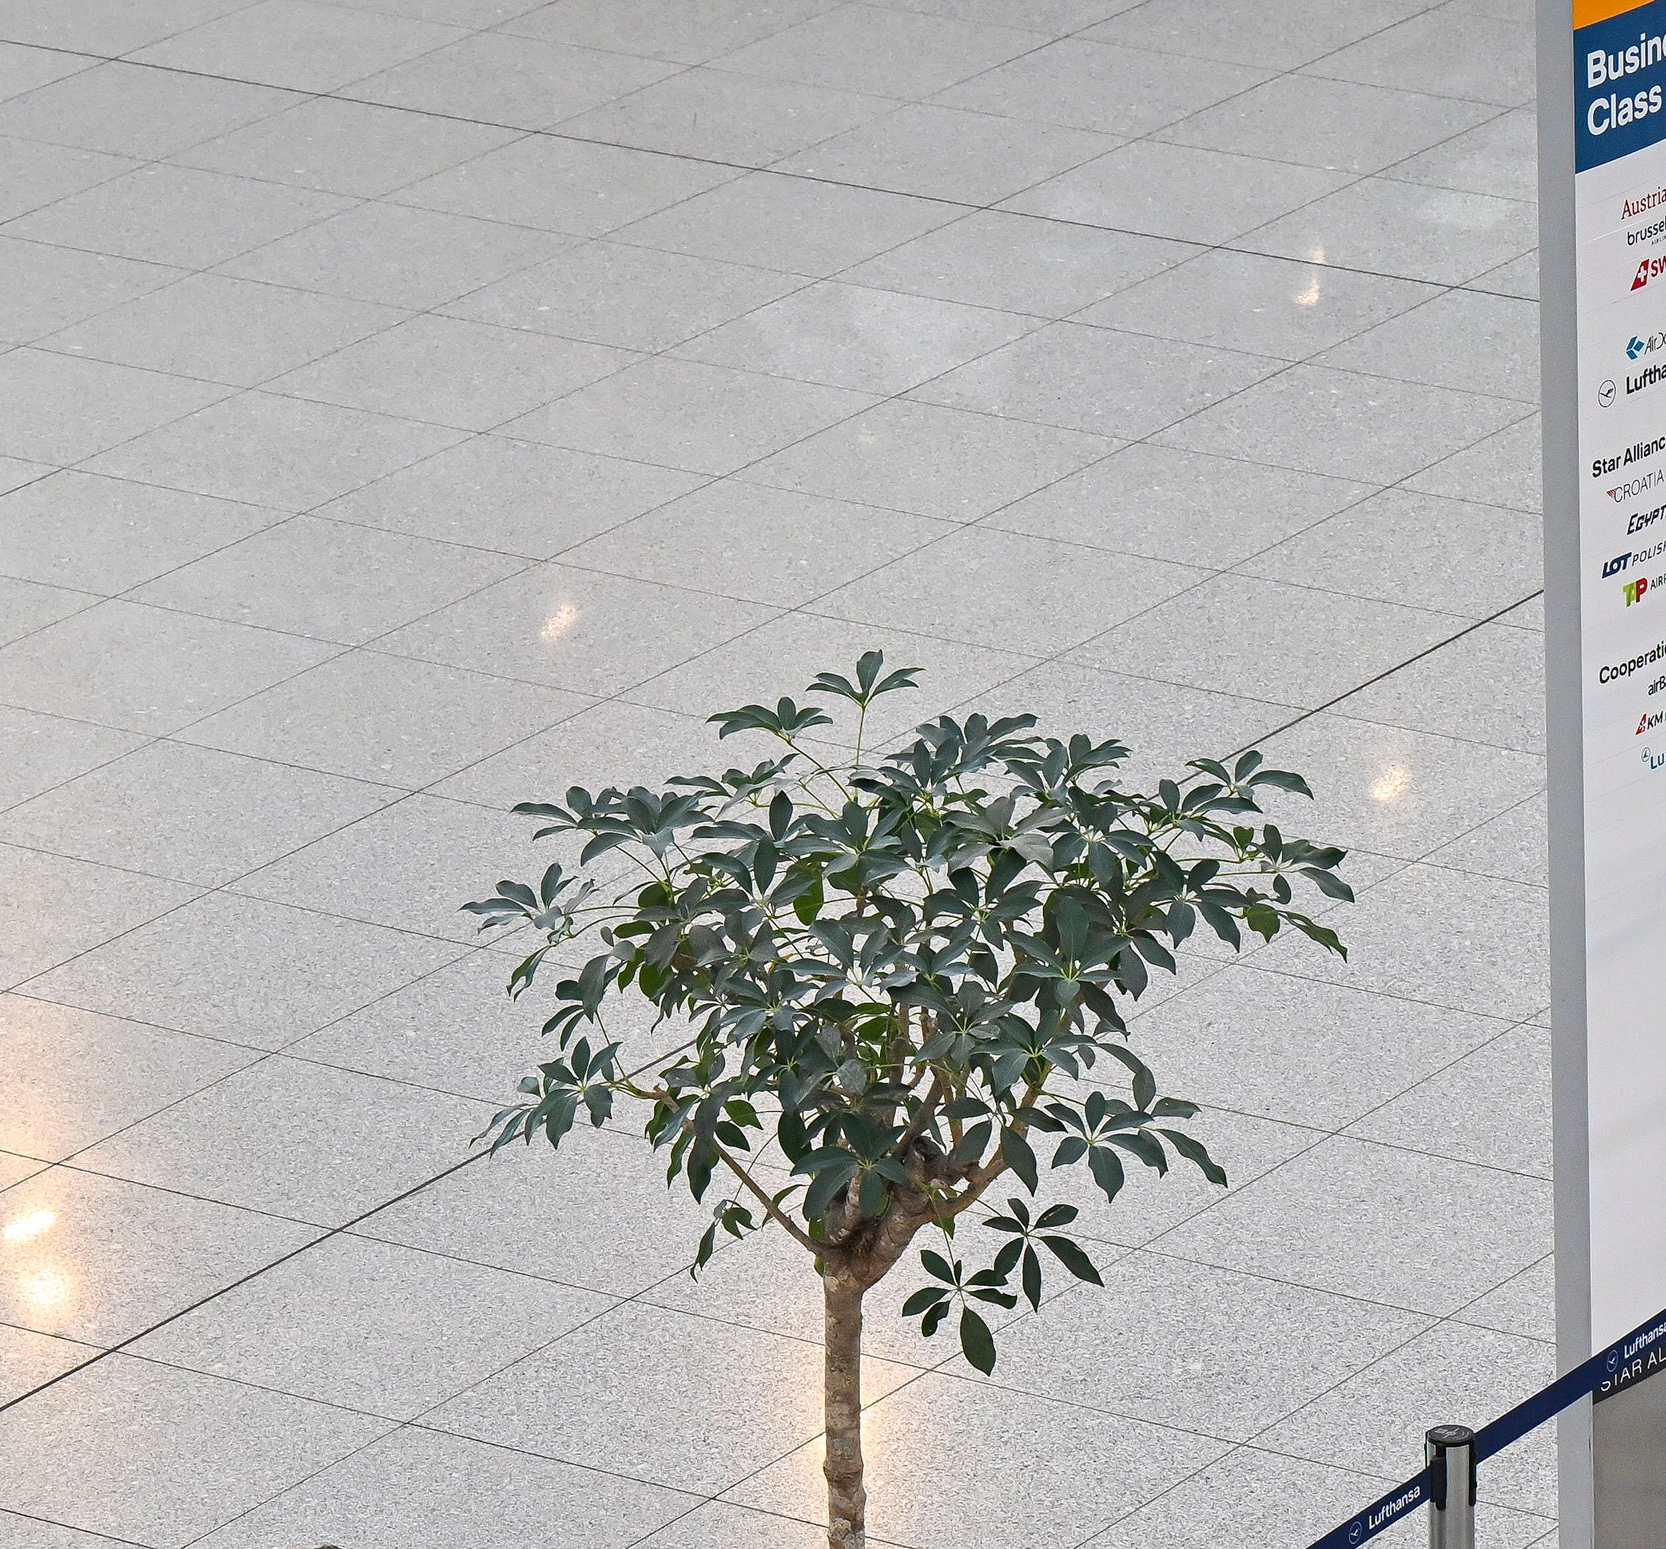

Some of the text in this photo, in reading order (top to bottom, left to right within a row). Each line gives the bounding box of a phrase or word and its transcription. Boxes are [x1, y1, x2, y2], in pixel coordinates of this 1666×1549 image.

[1587, 85, 1662, 136] Class
[1592, 455, 1621, 478] Star
[1614, 469, 1664, 503] CROATIA
[1602, 552, 1633, 579] LOT
[1622, 577, 1648, 607] TAP
[1647, 710, 1664, 730] KM
[1368, 1485, 1421, 1530] Lufthansa
